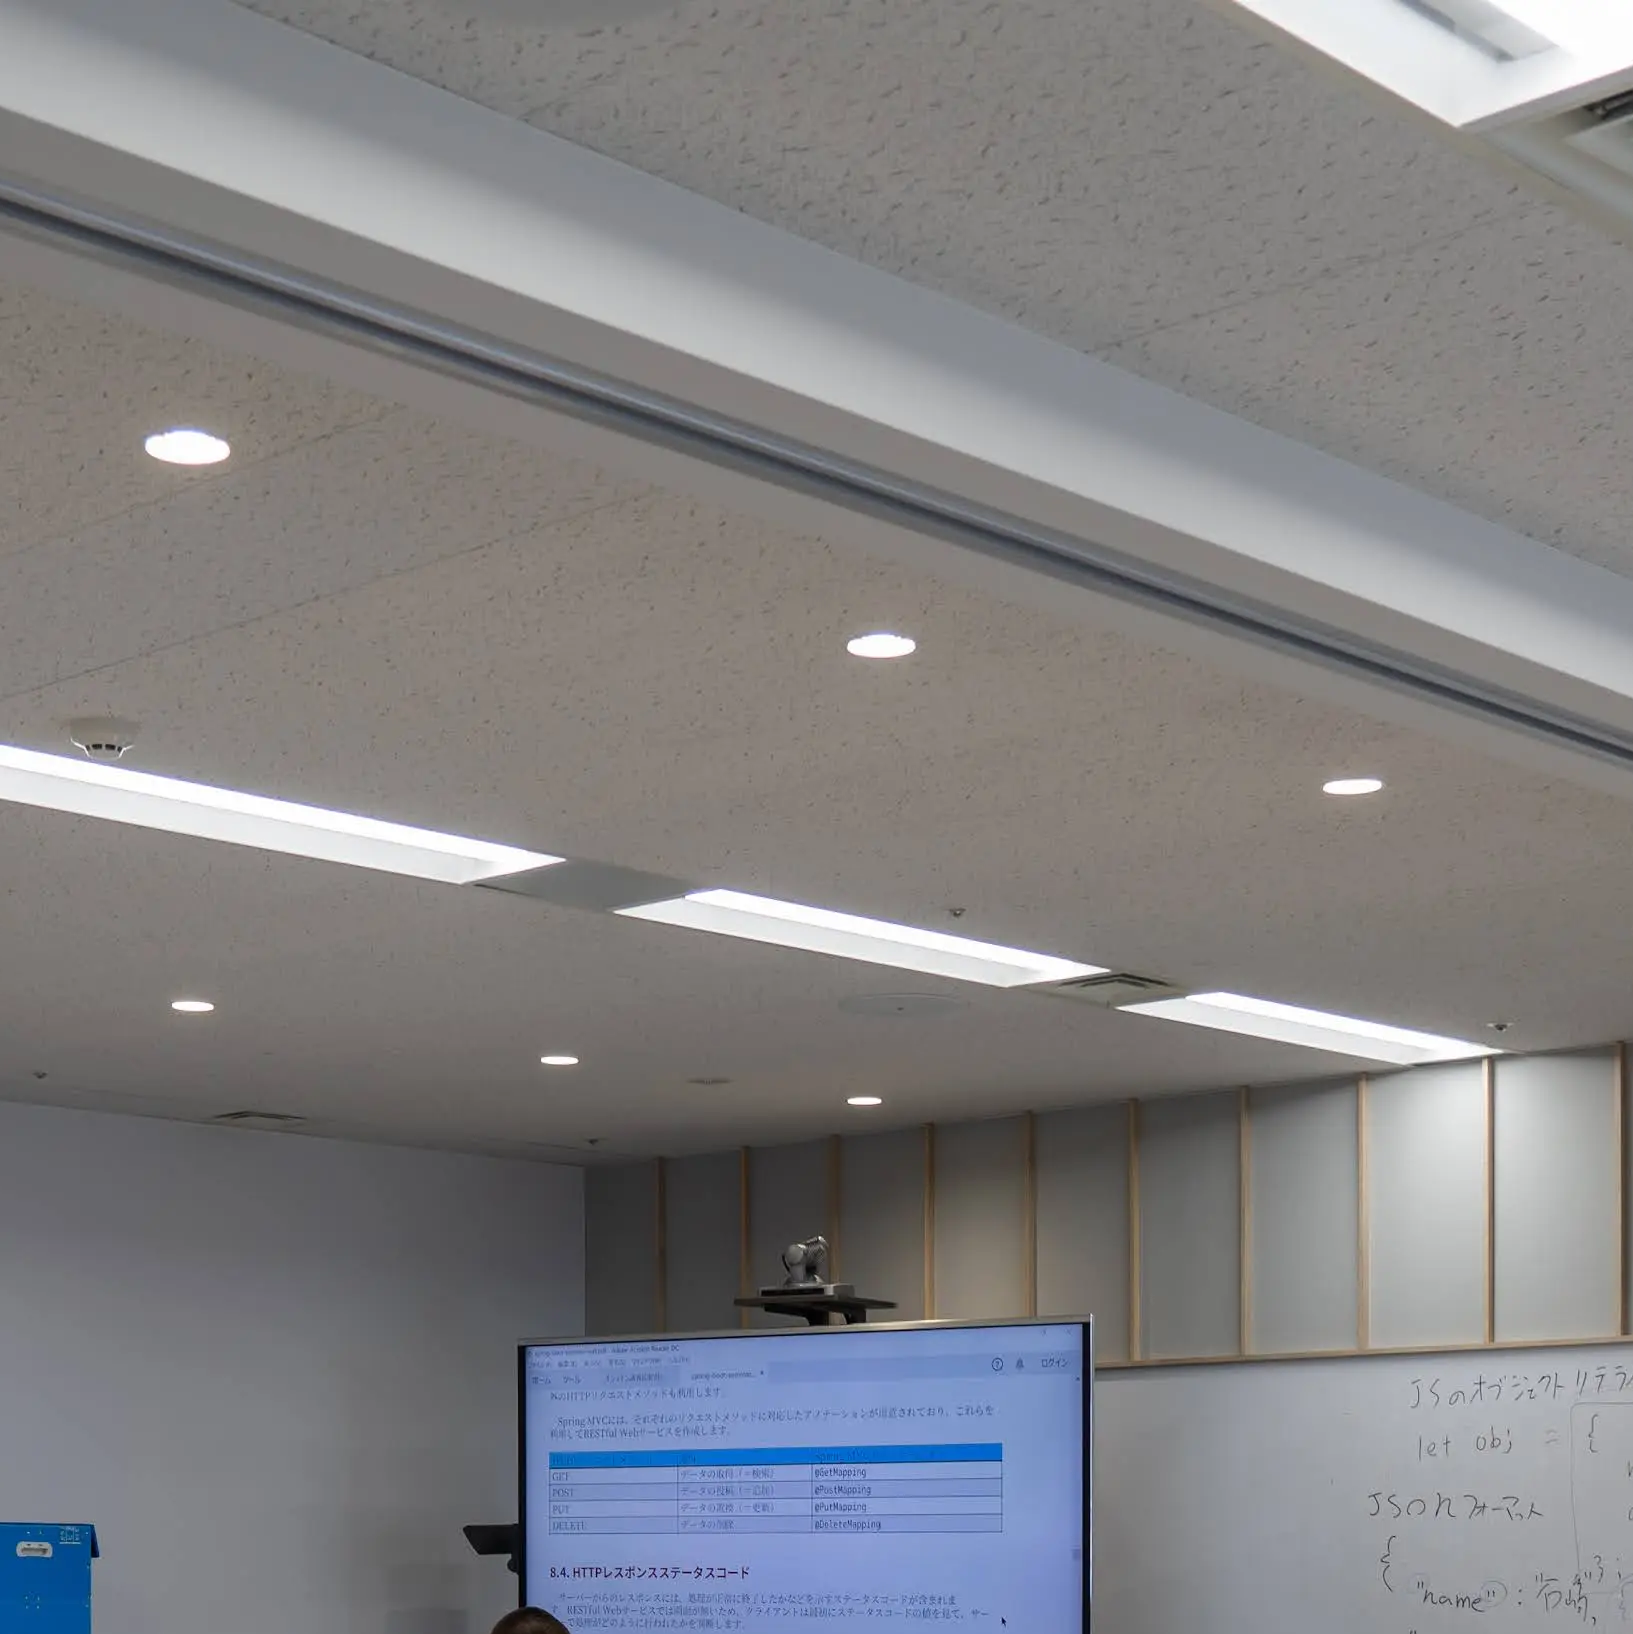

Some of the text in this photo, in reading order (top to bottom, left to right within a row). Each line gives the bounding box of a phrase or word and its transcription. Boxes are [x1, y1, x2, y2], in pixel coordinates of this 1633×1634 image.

[1041, 1358, 1068, 1368] ログイン
[558, 1416, 586, 1428] Spring
[1418, 1433, 1452, 1462] let
[1475, 1425, 1513, 1454] obj
[815, 1467, 866, 1479] @GetMapping
[552, 1488, 574, 1498] POST
[815, 1485, 871, 1496] @PostMapping
[815, 1502, 867, 1513] @PutMapping
[815, 1519, 882, 1531] @DeleteMapping
[550, 1566, 750, 1580] 8.4. HTTPレスポンスステータスコード
